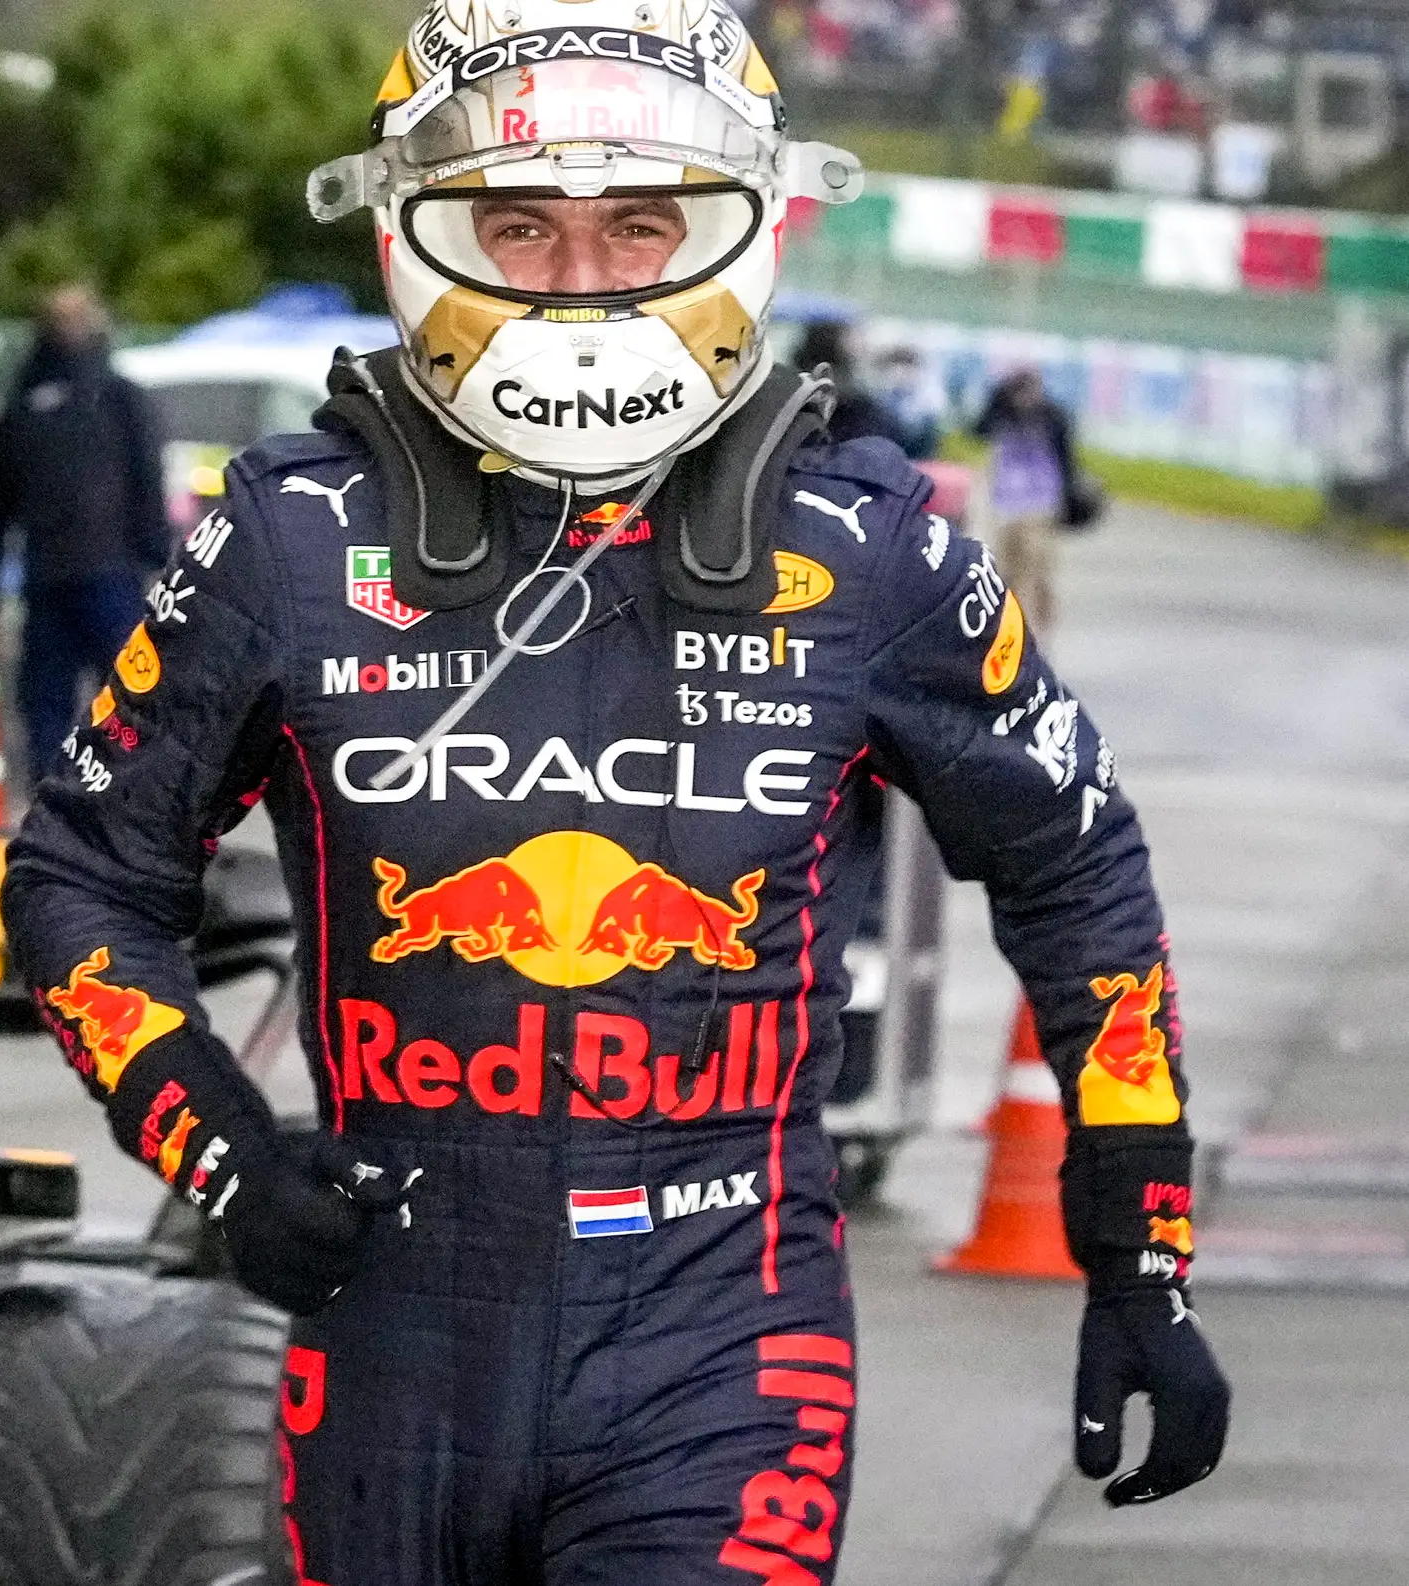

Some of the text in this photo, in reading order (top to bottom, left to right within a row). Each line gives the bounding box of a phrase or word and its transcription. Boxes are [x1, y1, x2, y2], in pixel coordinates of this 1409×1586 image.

[459, 26, 697, 81] ORACLE
[491, 377, 685, 429] CarNext
[321, 651, 440, 696] Mobil
[674, 626, 815, 679] BYBIT
[713, 689, 814, 728] Tezos
[332, 733, 818, 815] ORACLE
[338, 999, 780, 1121] Red Bull
[662, 1171, 761, 1221] MAX
[738, 1333, 855, 1562] Bull
